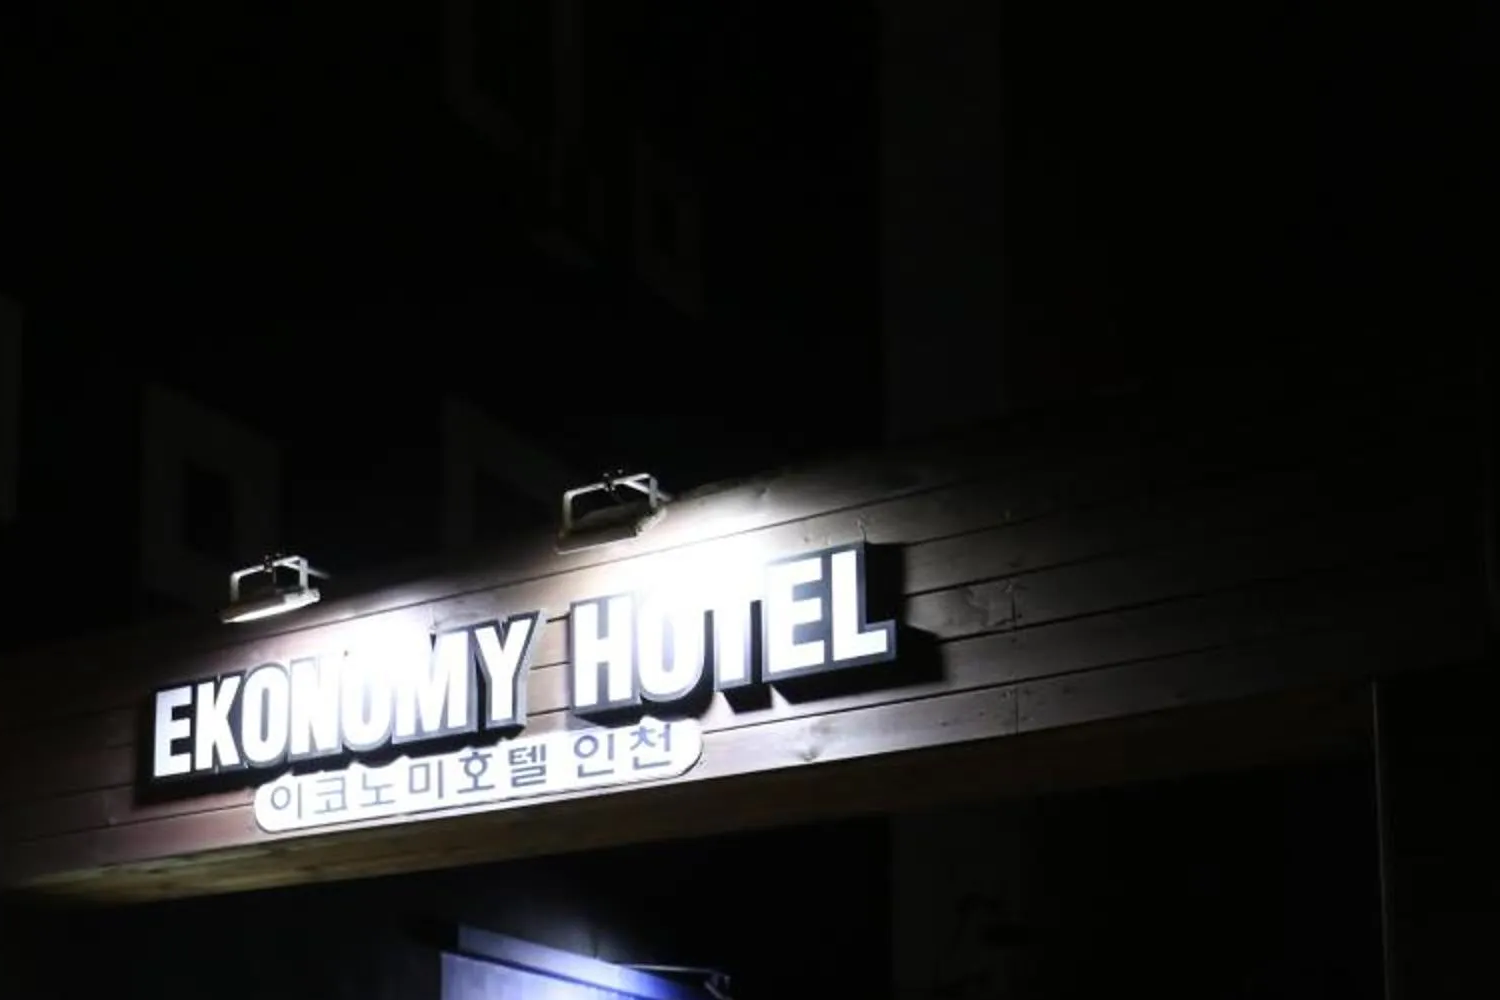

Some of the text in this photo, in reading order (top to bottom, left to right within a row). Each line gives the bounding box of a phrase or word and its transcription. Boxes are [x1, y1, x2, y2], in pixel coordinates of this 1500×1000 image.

[152, 552, 891, 778] EKONOMY HOTEL
[268, 721, 677, 822] 이코노미호텔 인천
